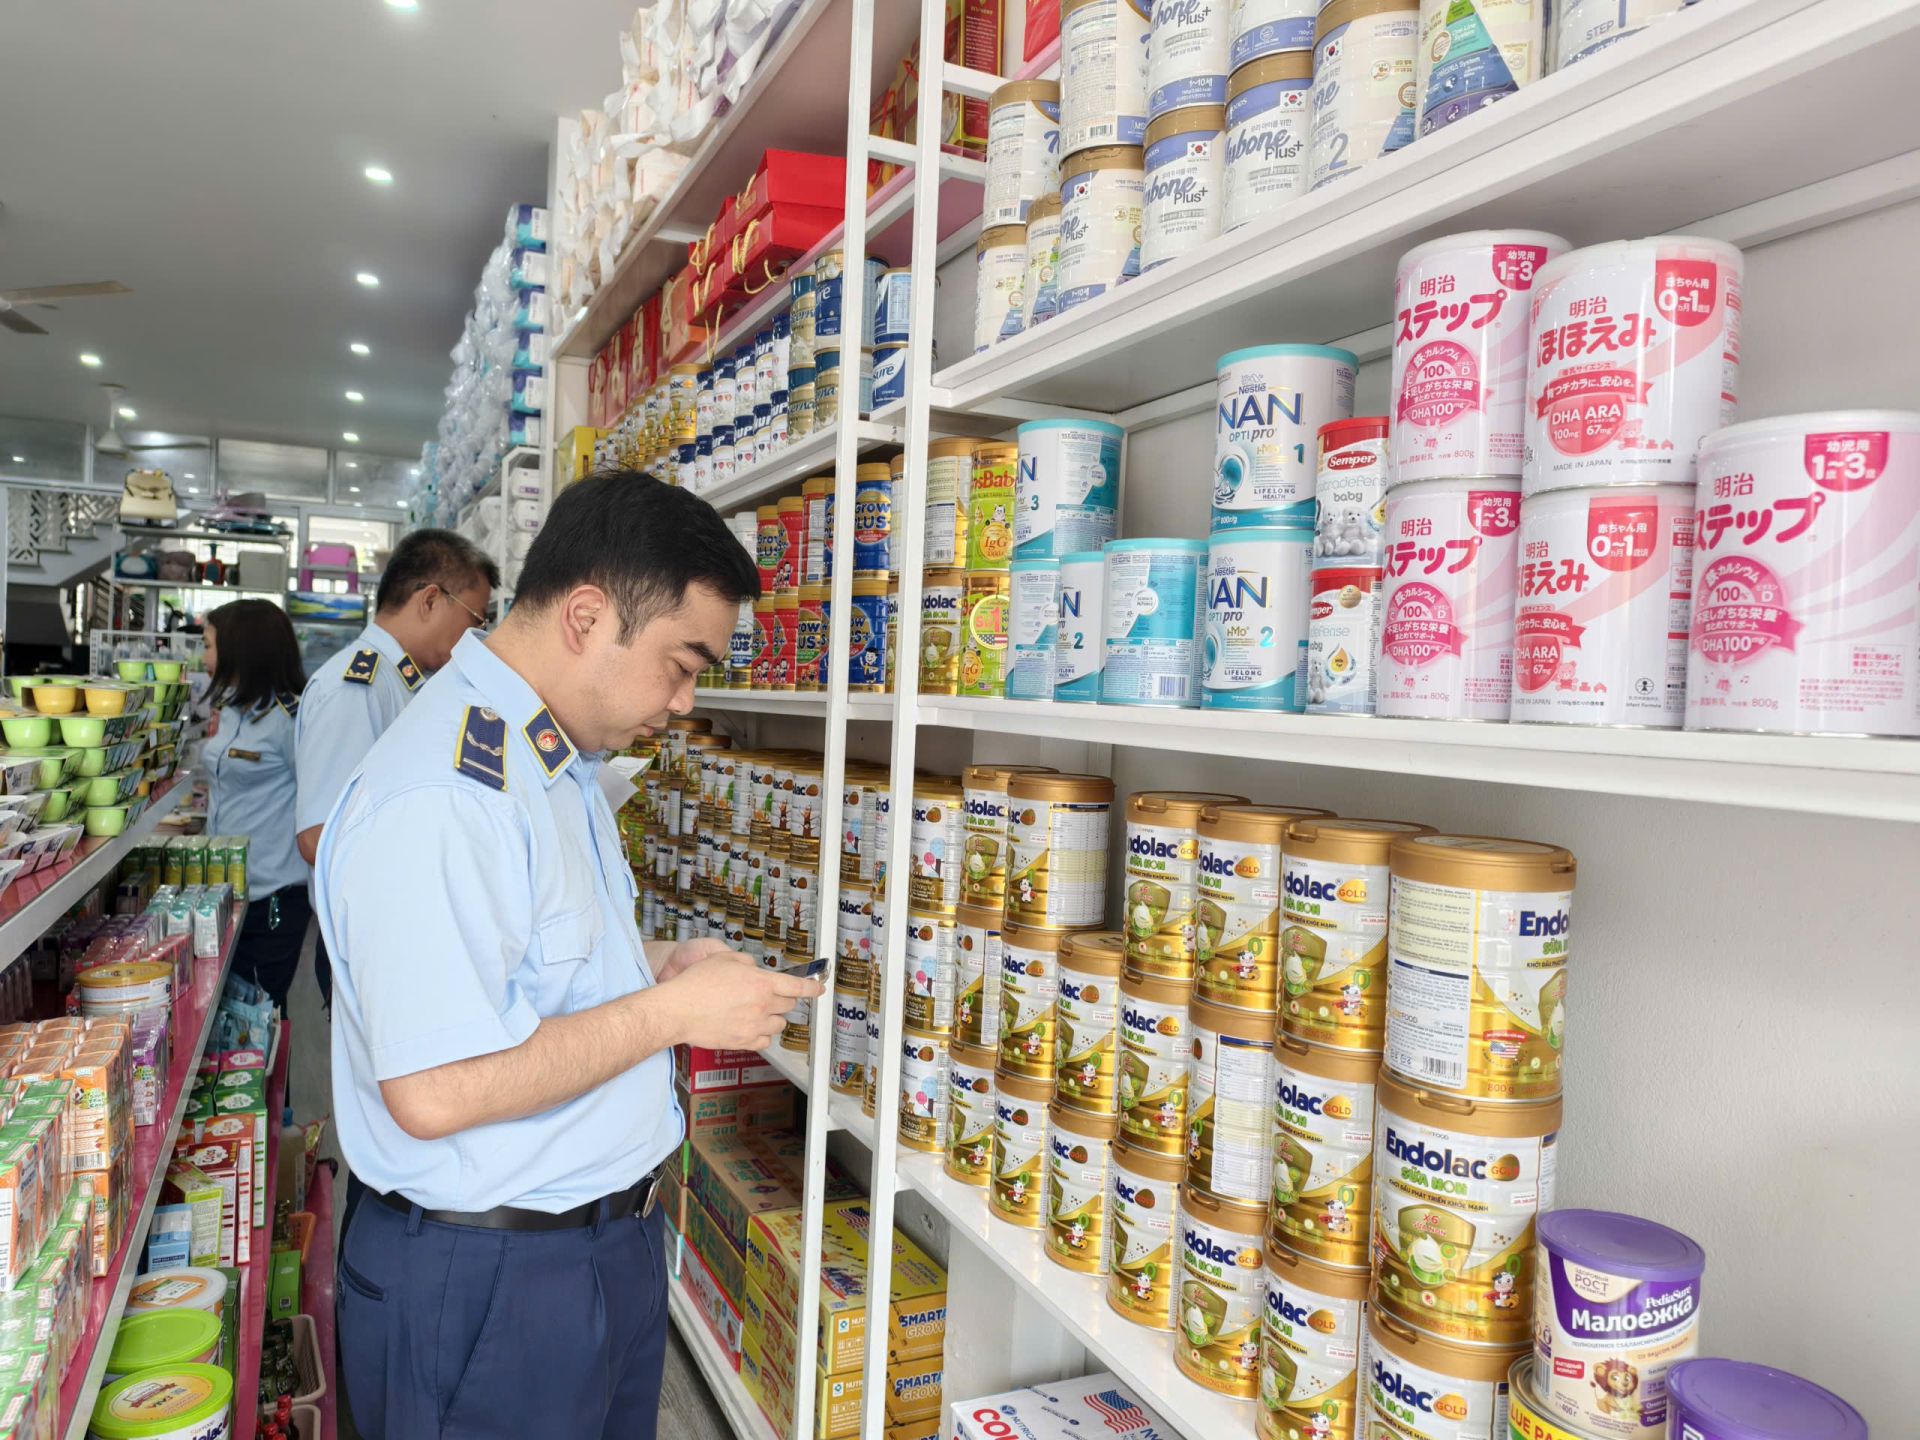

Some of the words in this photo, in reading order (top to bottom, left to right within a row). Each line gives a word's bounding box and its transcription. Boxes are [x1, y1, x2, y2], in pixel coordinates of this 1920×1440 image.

[1586, 20, 1615, 41] STEP
[1329, 132, 1349, 170] 2
[1420, 274, 1455, 297] 明治
[1569, 296, 1608, 317] 明治
[1396, 289, 1507, 347] ステップ
[1239, 382, 1267, 395] Nestlé
[1218, 393, 1305, 434] NAN
[1552, 409, 1581, 425] DHA
[1584, 404, 1621, 420] ARA
[1293, 443, 1305, 464] 1
[1827, 440, 1870, 452] 幼児用
[1553, 463, 1573, 472] MADE
[1586, 459, 1612, 468] JAPAN
[1254, 487, 1296, 495] LIFELONG
[1714, 473, 1754, 497] 明治
[1031, 495, 1039, 511] 3
[1334, 490, 1363, 503] baby
[1401, 518, 1432, 537] 明治
[984, 537, 1008, 549] IgG
[1526, 540, 1548, 558] 明治
[1384, 537, 1483, 577] ステップ
[1074, 632, 1083, 649] 2
[1259, 626, 1277, 648] 2
[1532, 645, 1558, 659] ARA
[1338, 890, 1366, 898] GOLD
[1323, 1103, 1352, 1115] GOLD
[1386, 1127, 1488, 1180] Endolac
[1575, 1274, 1609, 1292] РОСТ
[1571, 1295, 1693, 1332] Малоежка
[1370, 1355, 1433, 1413] dolac
[1435, 1401, 1468, 1416] GOLD
